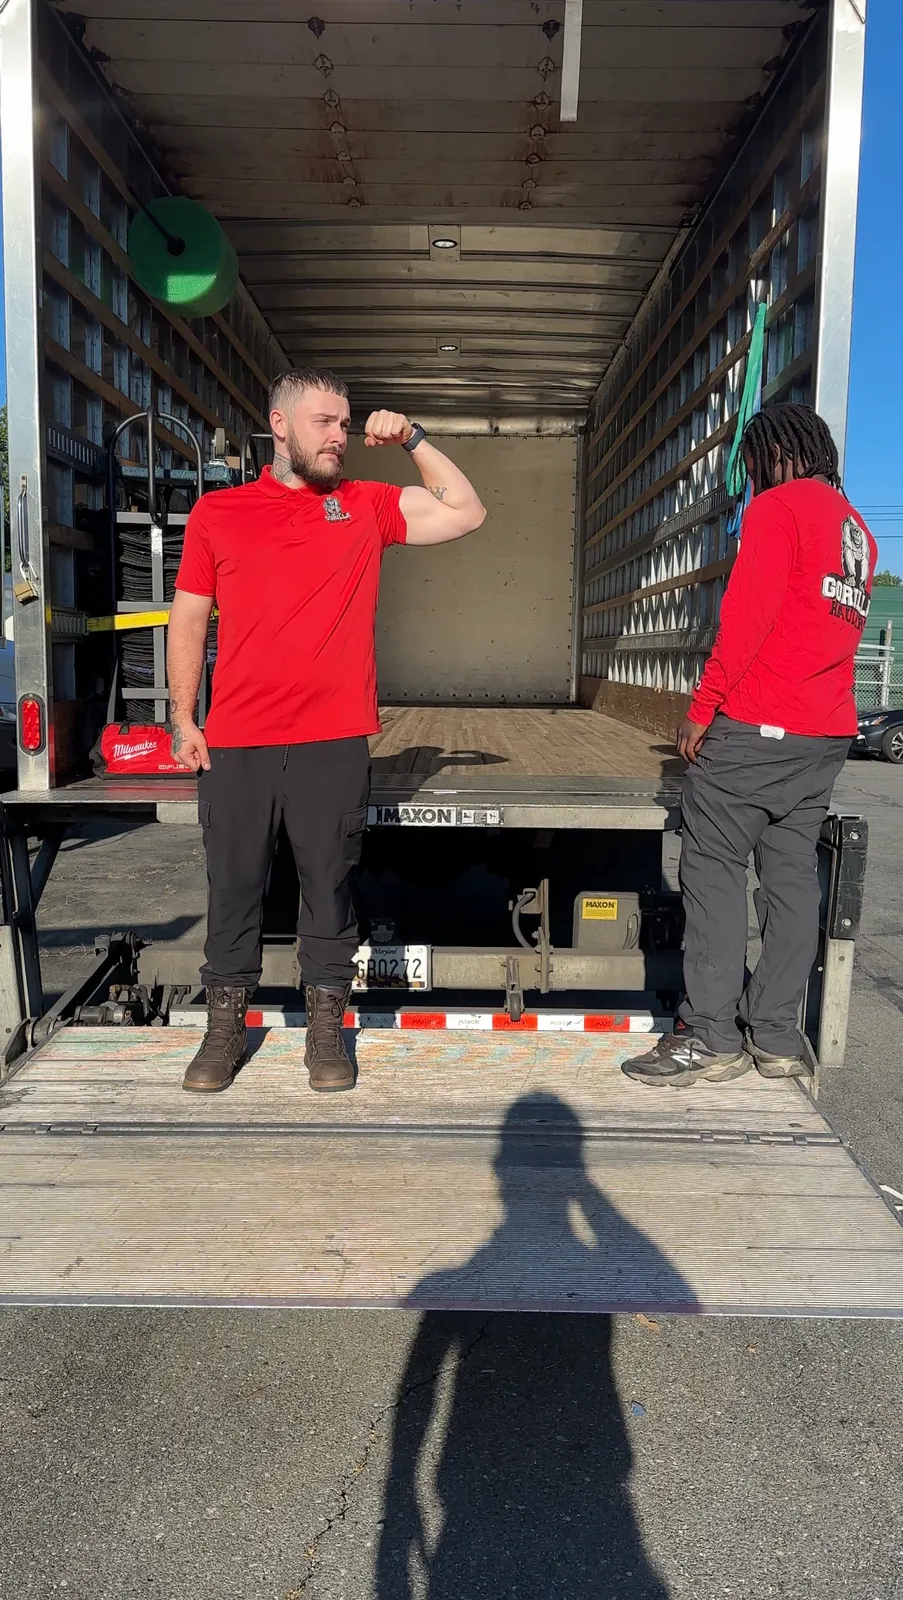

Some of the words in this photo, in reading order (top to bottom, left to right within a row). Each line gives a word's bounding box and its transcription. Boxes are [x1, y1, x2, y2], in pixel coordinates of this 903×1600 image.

[112, 740, 158, 757] Milwaukee
[384, 808, 452, 824] MAXON
[371, 948, 398, 956] Maryland
